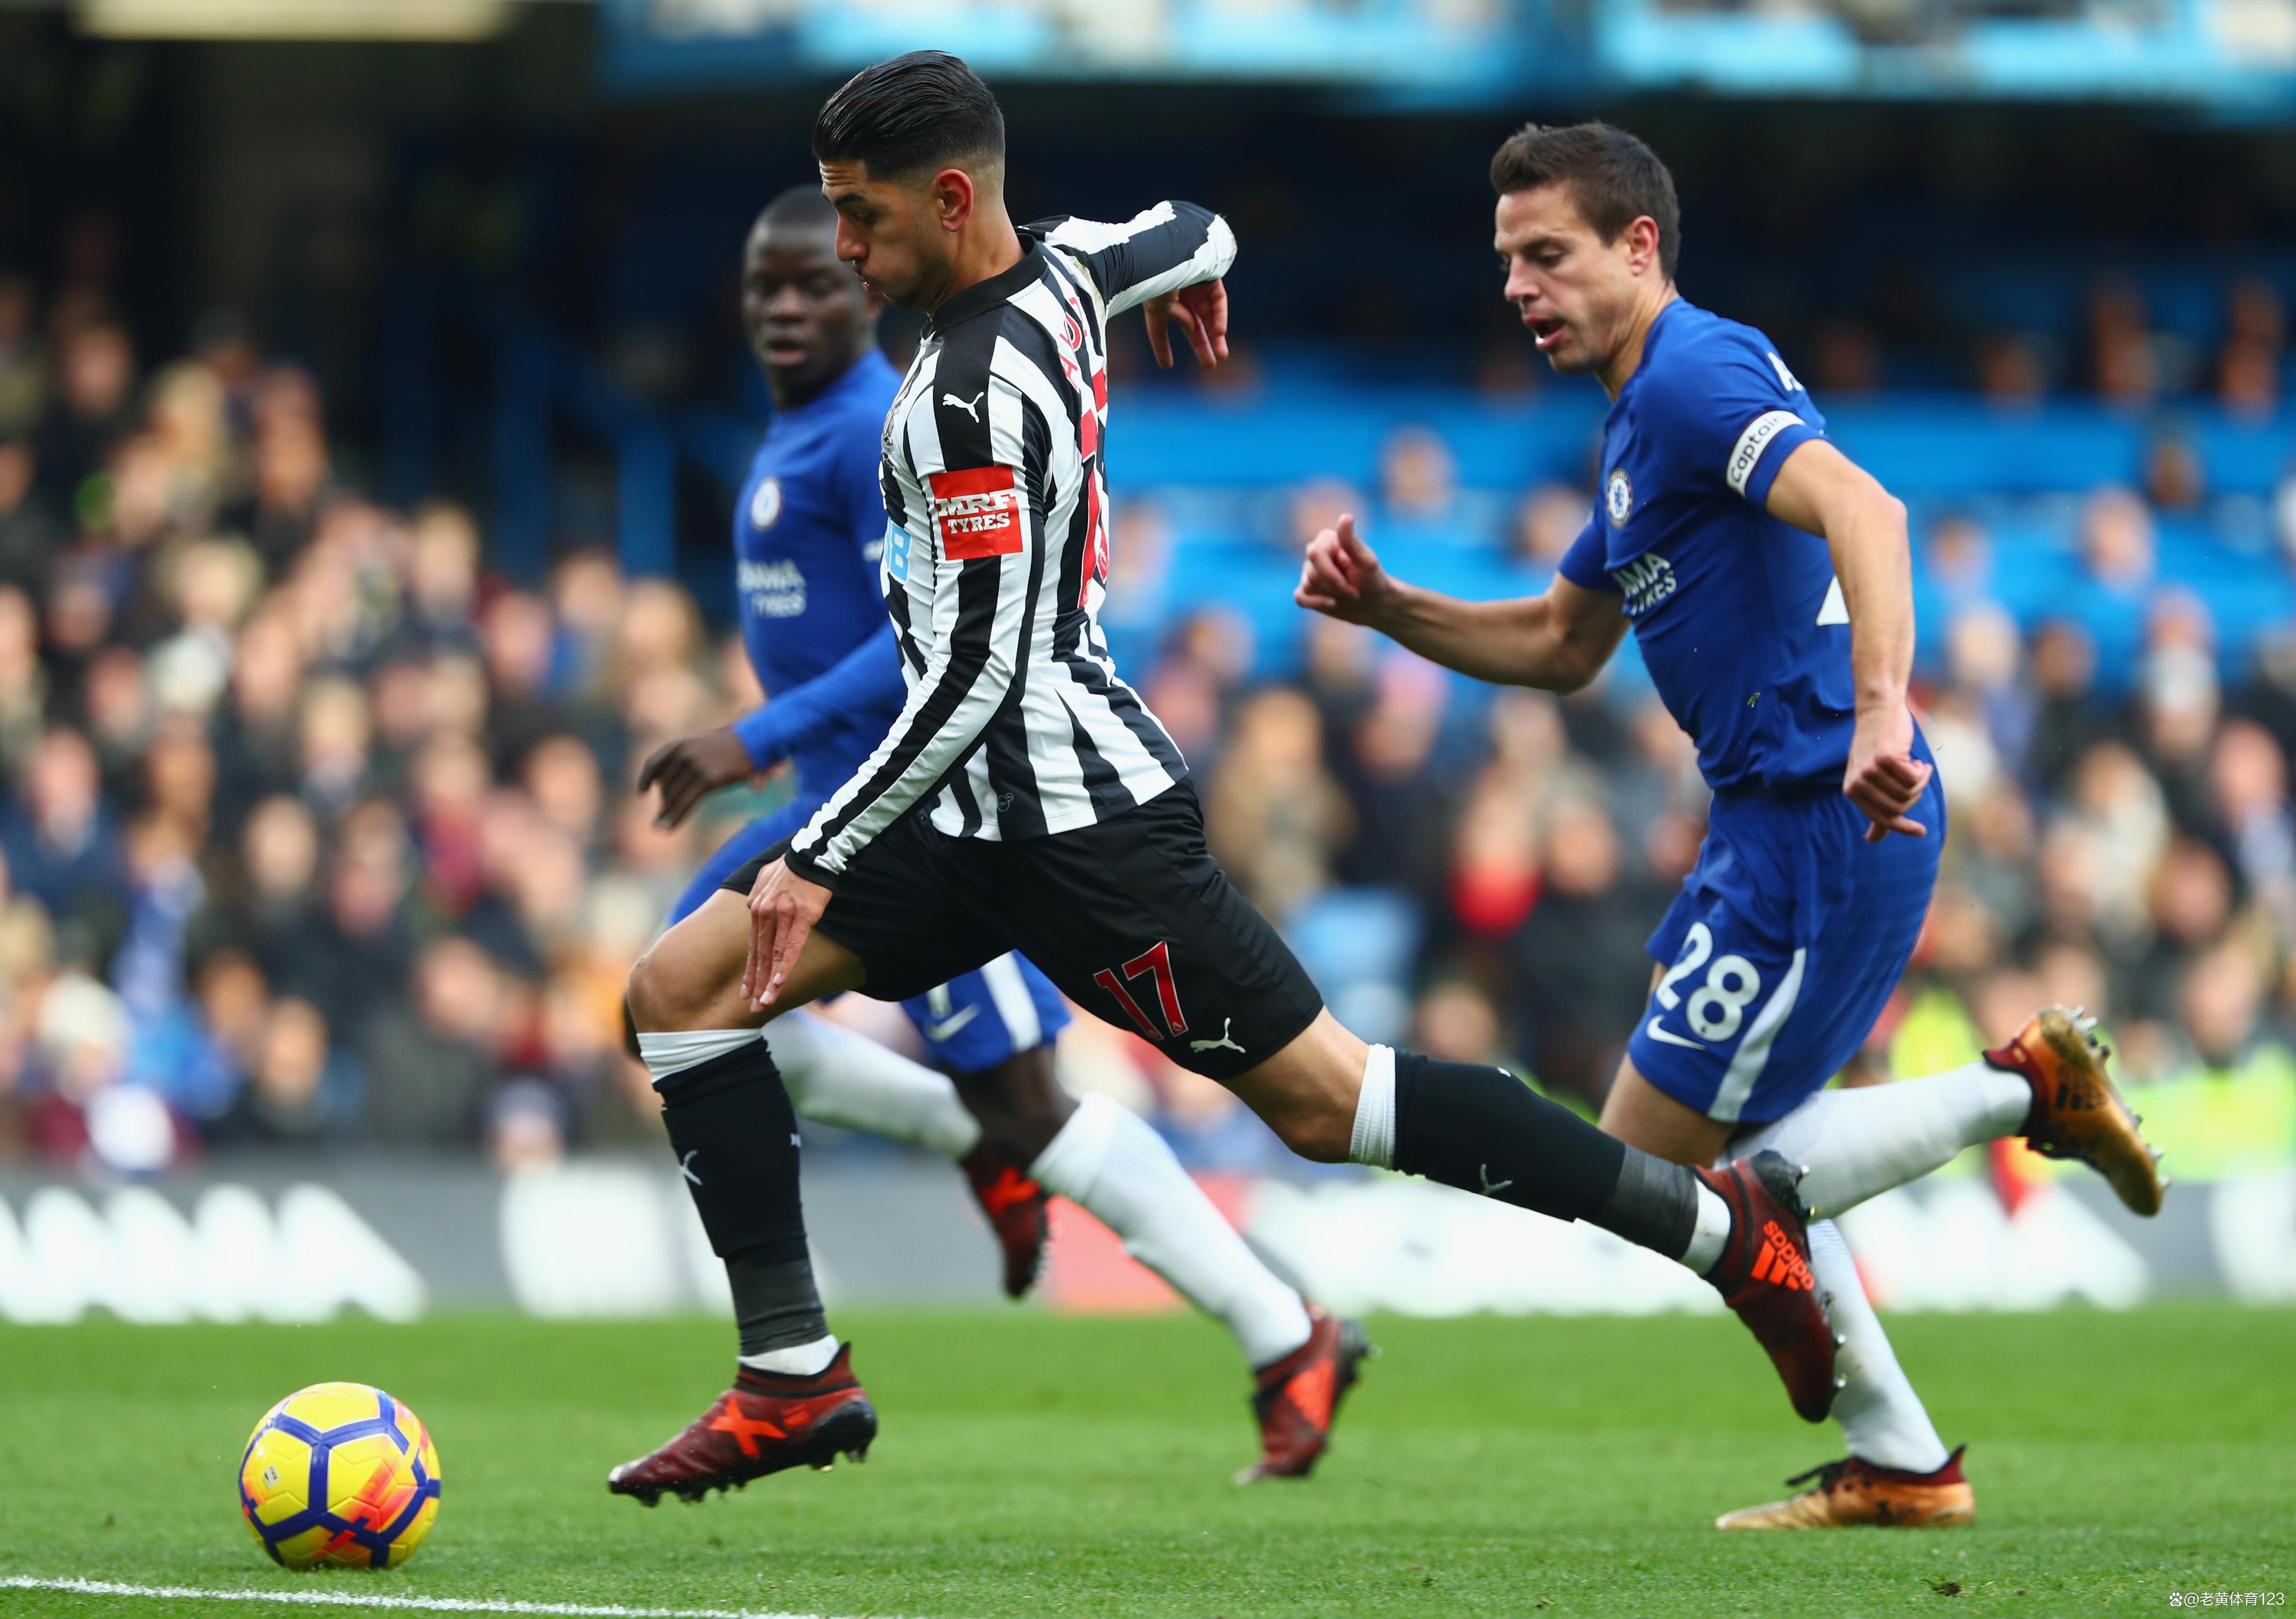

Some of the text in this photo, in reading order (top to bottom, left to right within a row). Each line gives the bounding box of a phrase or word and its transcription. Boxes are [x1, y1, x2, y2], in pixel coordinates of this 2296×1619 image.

[936, 488, 1016, 517] MRF
[947, 512, 1011, 534] TYRES
[1093, 940, 1189, 1040] 17
[1656, 922, 1760, 1042] 28
[1763, 1219, 1815, 1291] adidas
